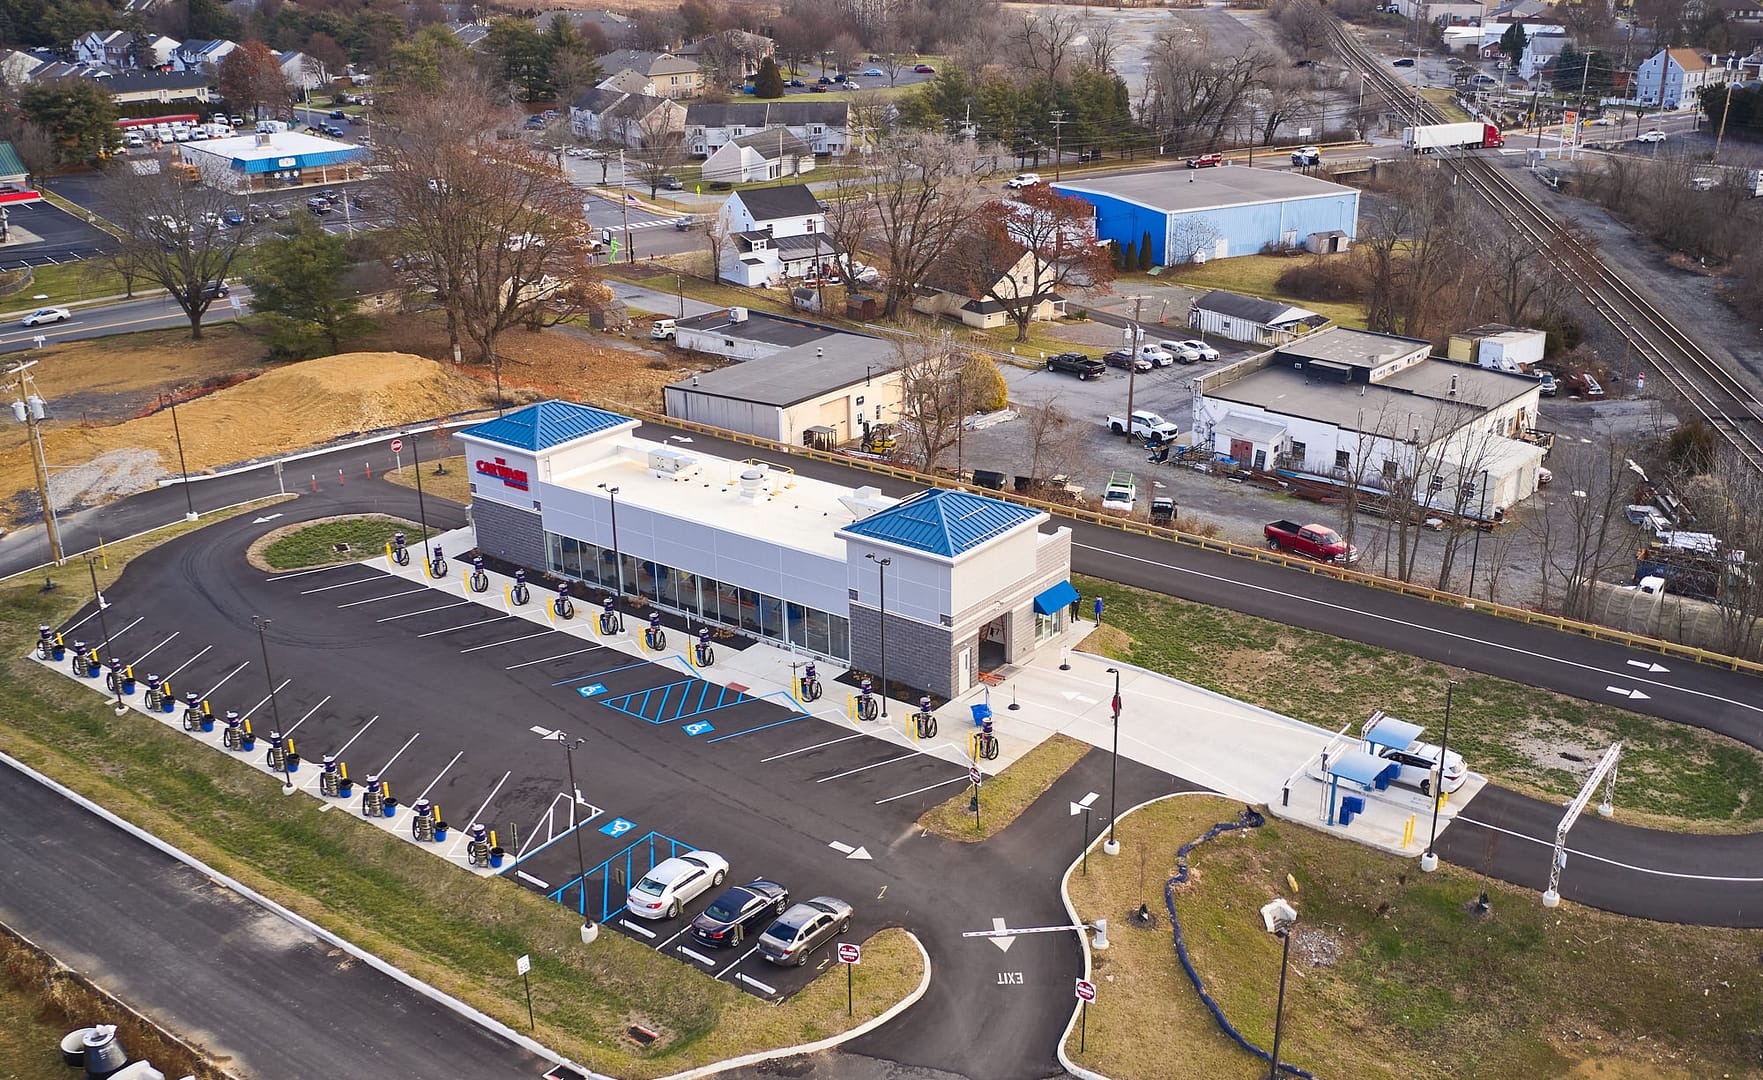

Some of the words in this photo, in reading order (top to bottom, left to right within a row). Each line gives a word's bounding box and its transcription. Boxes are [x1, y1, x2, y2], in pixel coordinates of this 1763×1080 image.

[476, 460, 497, 475] CAR
[496, 465, 528, 483] WASH
[997, 972, 1024, 984] EXIT
